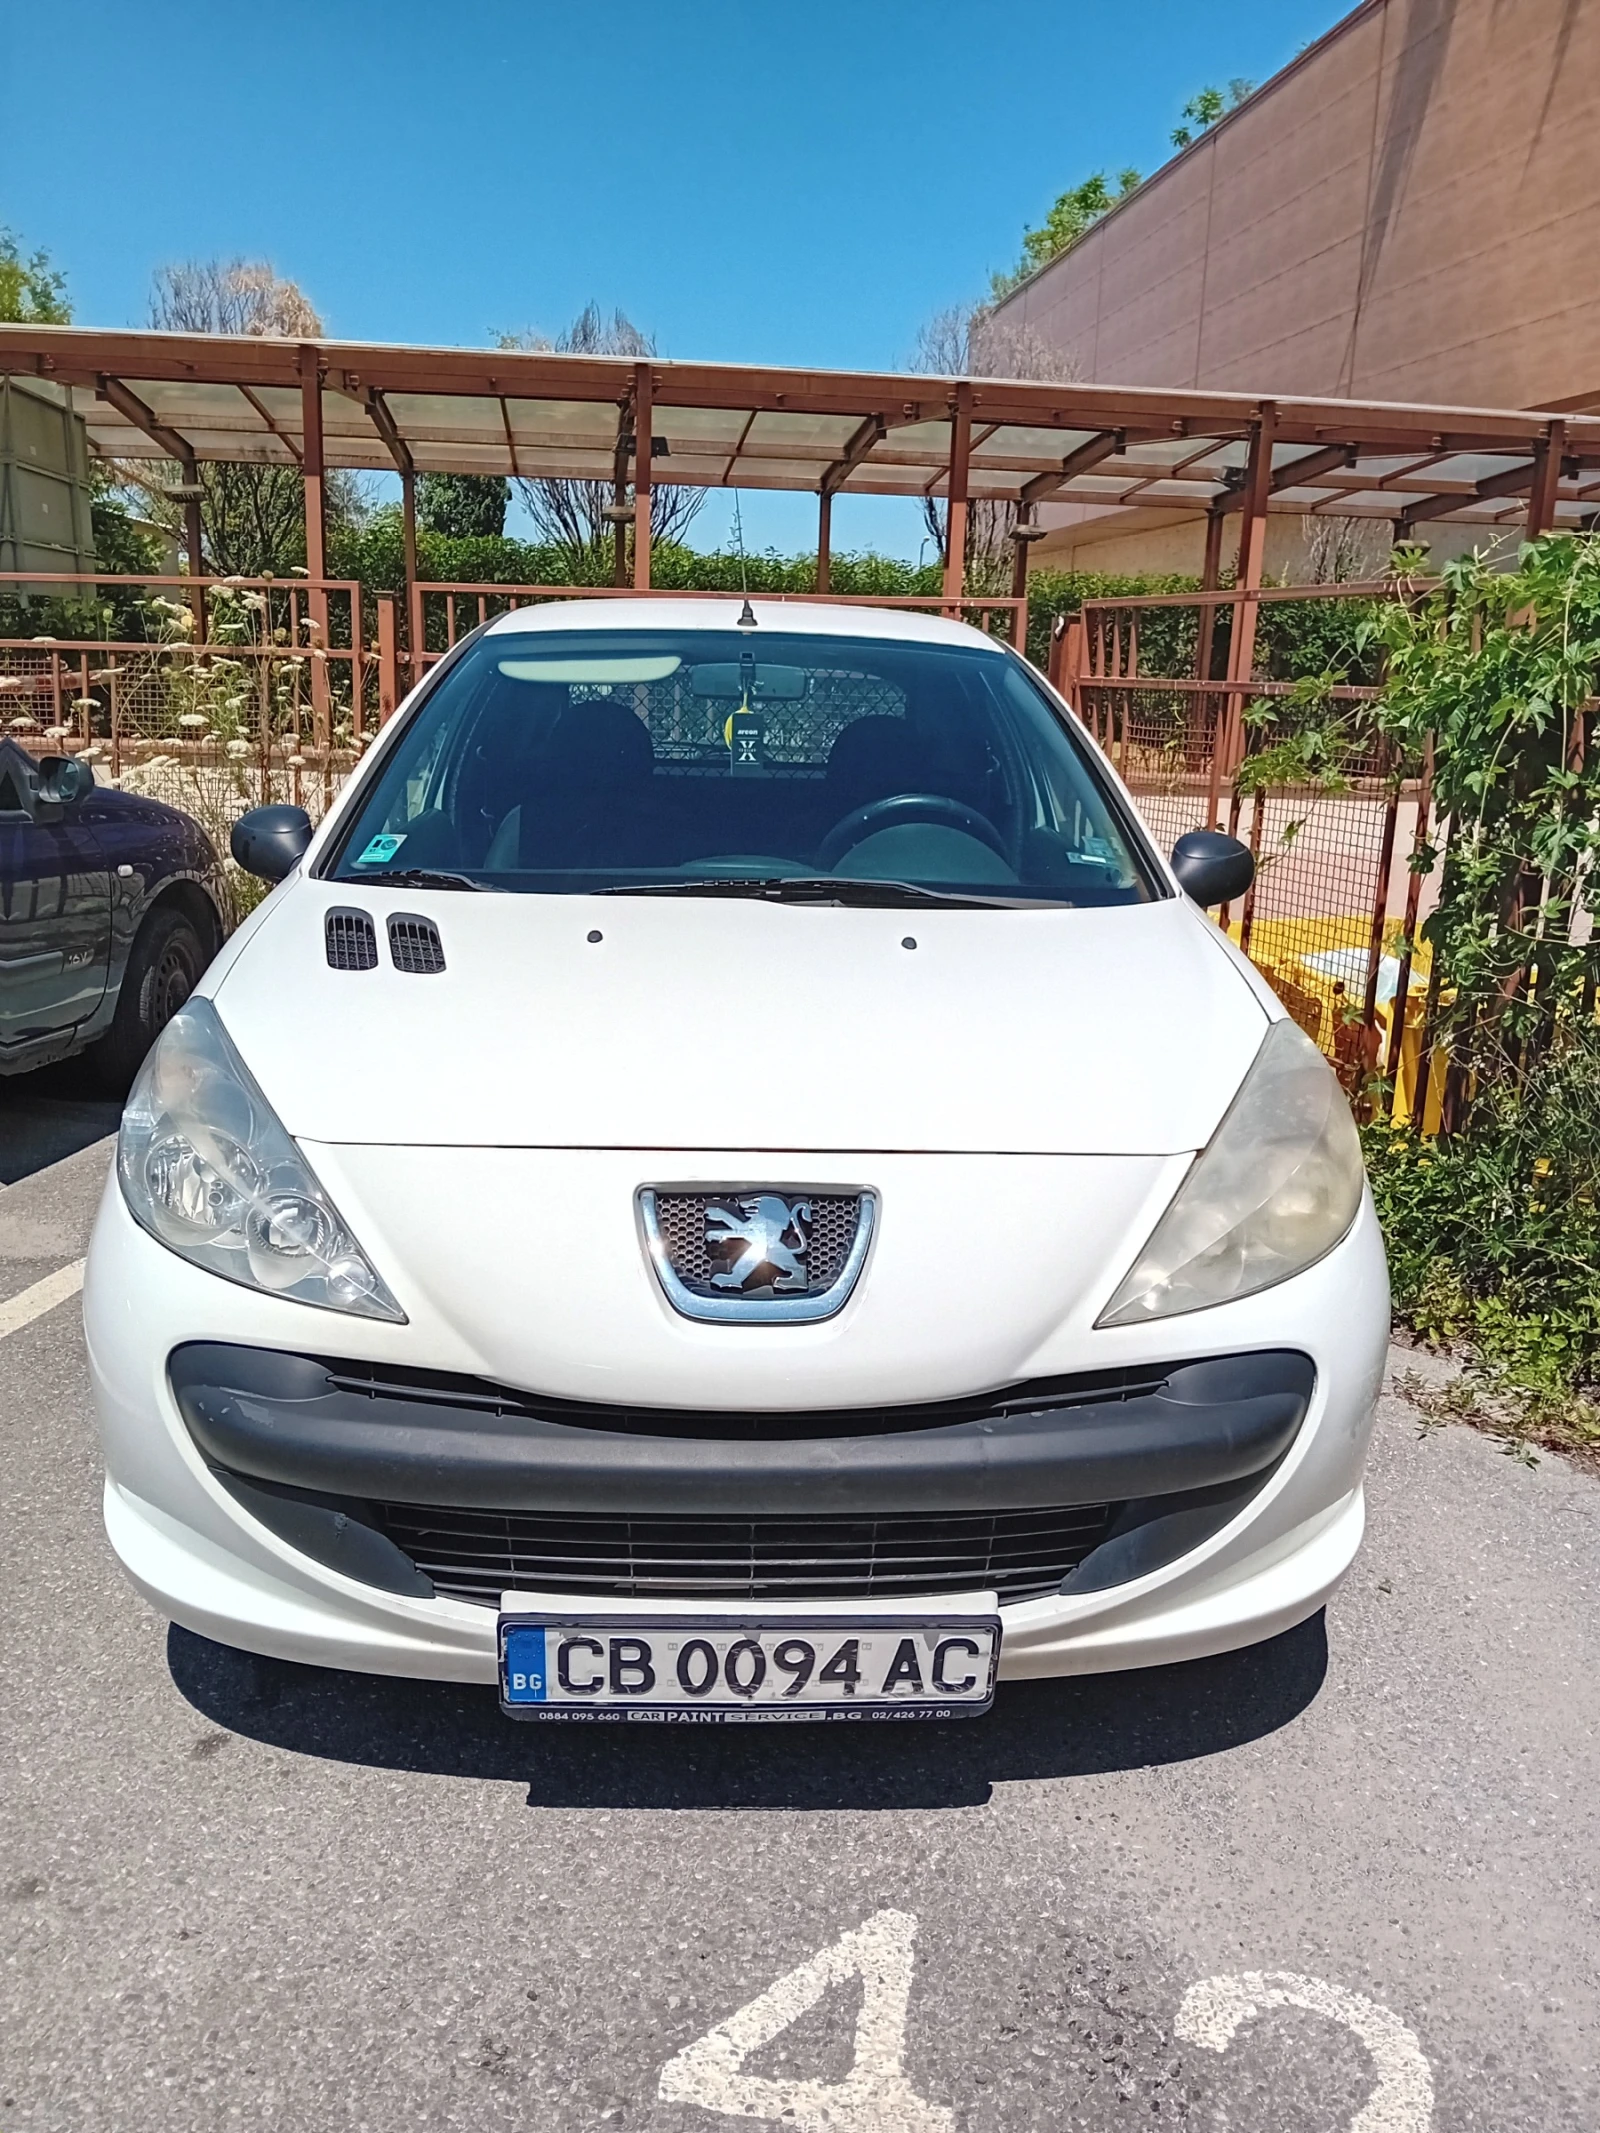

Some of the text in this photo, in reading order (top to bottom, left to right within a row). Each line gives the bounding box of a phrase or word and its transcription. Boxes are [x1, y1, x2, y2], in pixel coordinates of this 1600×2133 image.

[557, 1636, 979, 1697] CB 0094 AC
[513, 1673, 542, 1690] BG
[538, 1712, 568, 1721] 0884
[571, 1712, 594, 1721] 095
[597, 1712, 620, 1721] 660
[871, 1710, 915, 1719] 02/426
[918, 1710, 934, 1718] 77
[936, 1709, 951, 1718] 00
